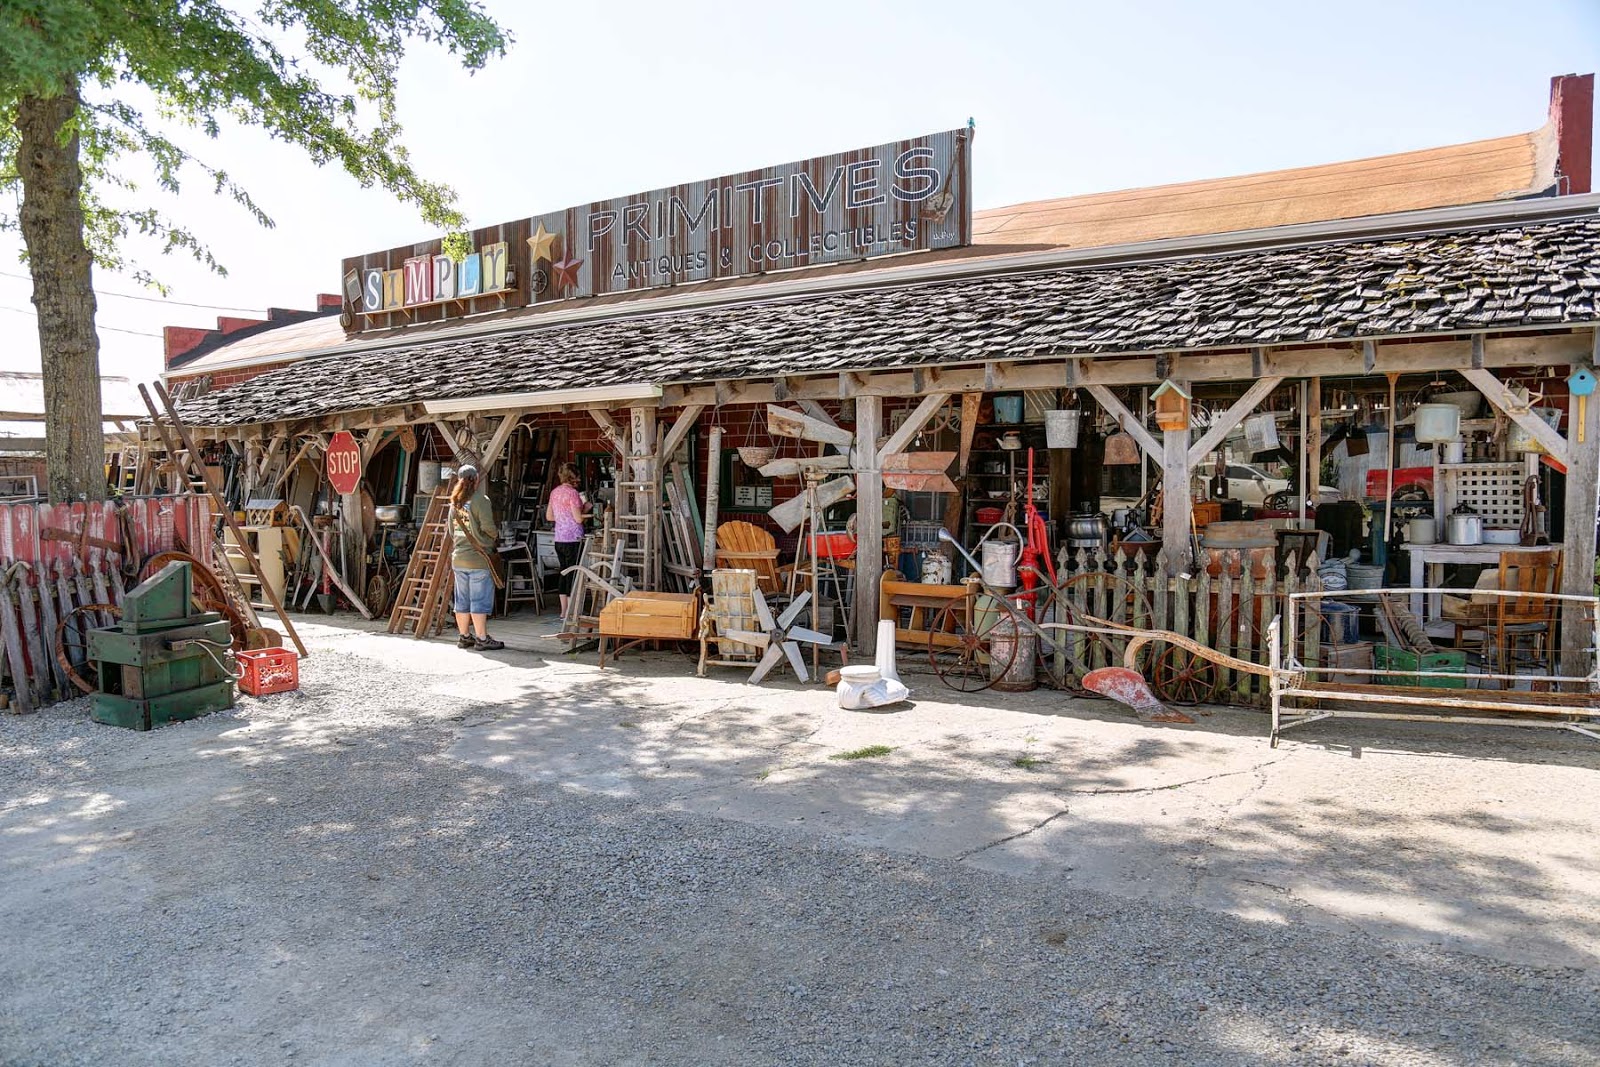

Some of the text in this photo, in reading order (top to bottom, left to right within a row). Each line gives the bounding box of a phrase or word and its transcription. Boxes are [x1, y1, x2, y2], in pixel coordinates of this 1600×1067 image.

[587, 147, 940, 252] PRIMITIVES
[365, 248, 504, 310] SIMPLY
[611, 218, 918, 281] ANTIQUES & COLLECTIBLES
[329, 450, 359, 475] STOP
